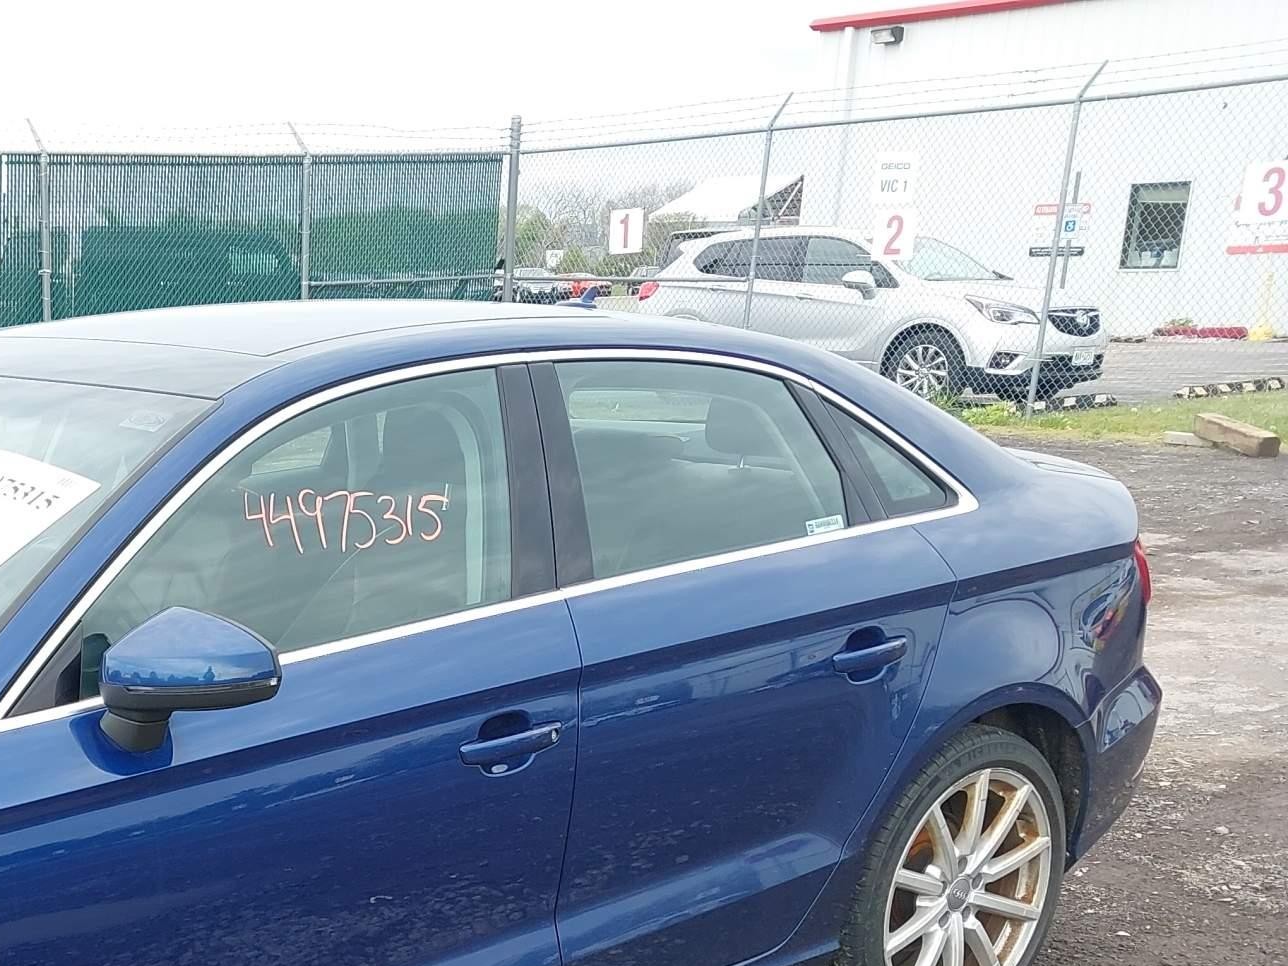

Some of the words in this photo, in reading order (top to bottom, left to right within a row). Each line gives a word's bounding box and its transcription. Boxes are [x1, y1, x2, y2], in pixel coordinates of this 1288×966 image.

[880, 162, 911, 170] GEICO
[880, 179, 899, 193] VIC
[903, 180, 908, 193] 1
[1257, 166, 1286, 217] 3
[619, 213, 630, 249] 1
[883, 214, 904, 256] 2
[244, 488, 449, 554] 44975315
